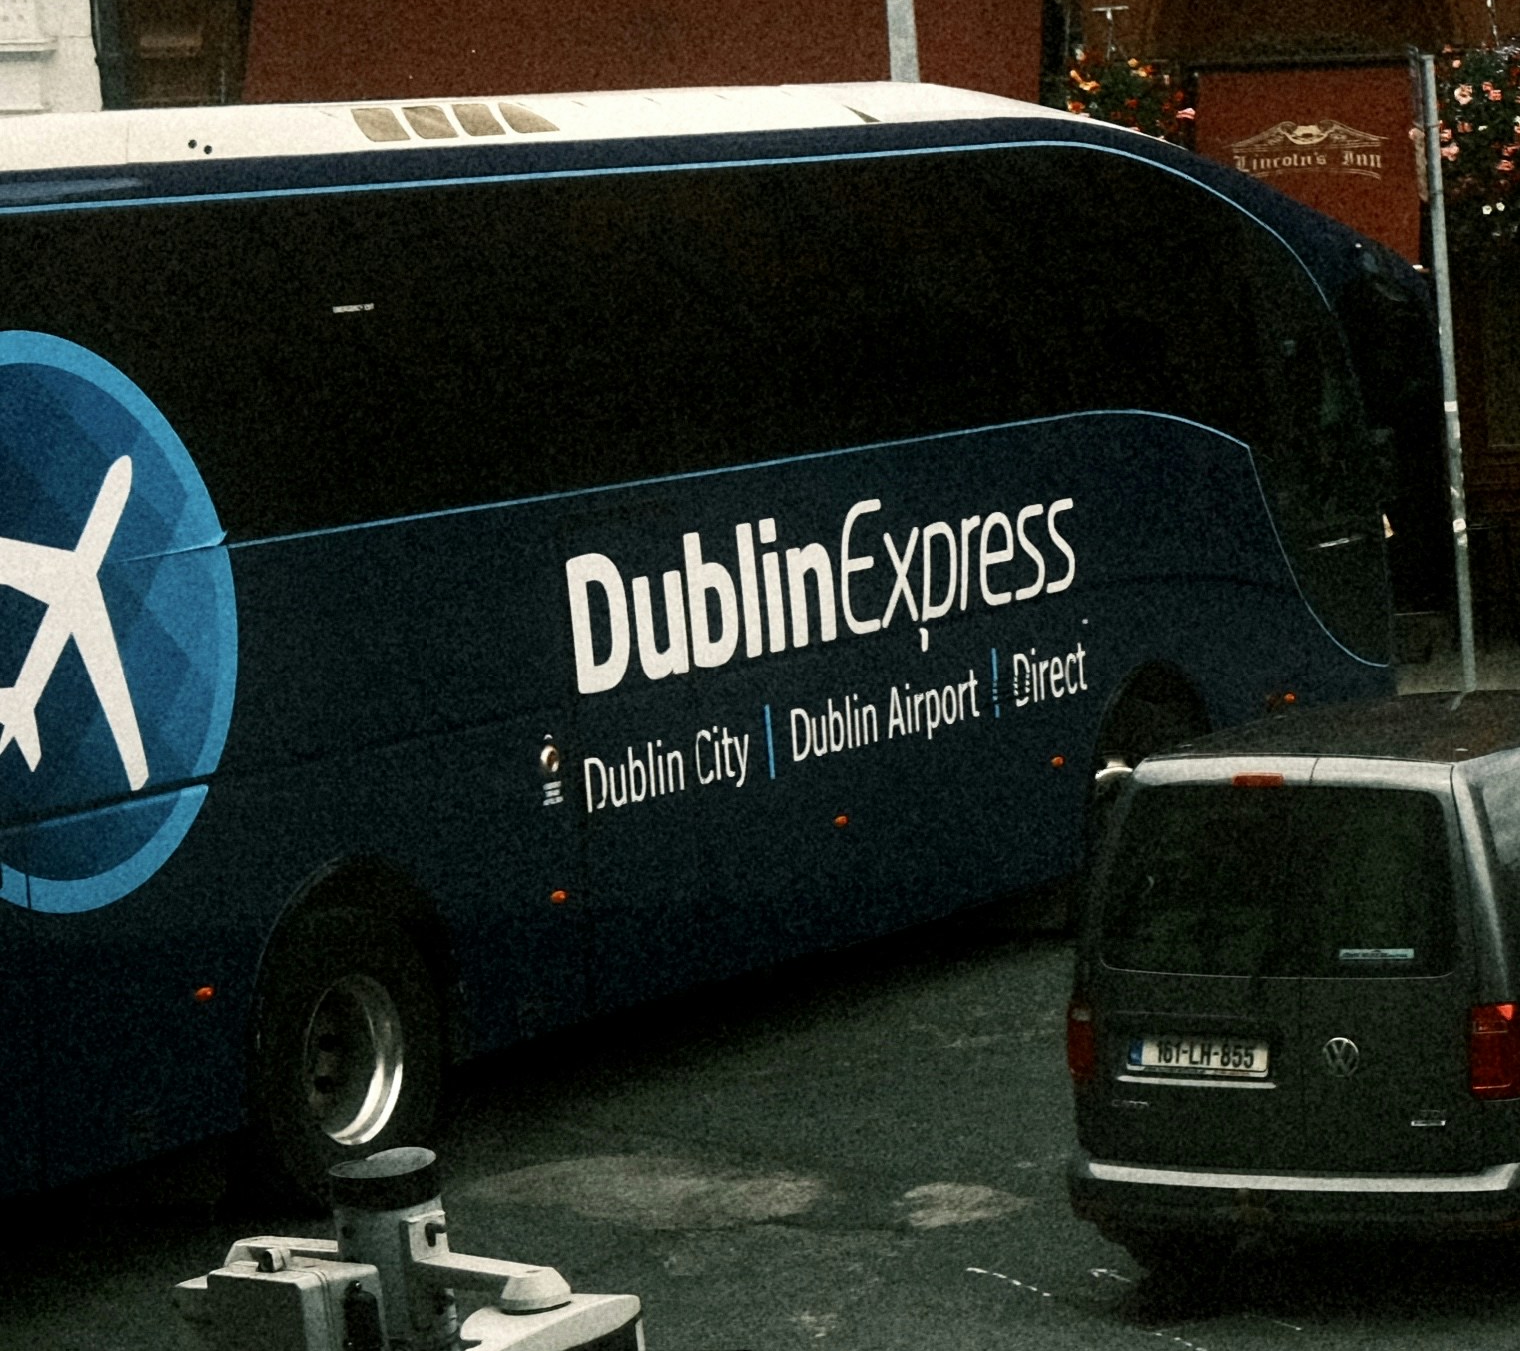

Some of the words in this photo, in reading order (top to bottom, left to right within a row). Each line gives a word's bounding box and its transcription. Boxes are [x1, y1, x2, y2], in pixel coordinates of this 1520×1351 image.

[1233, 151, 1328, 173] Lincoln's
[1341, 150, 1383, 169] Inn
[565, 498, 1075, 696] DublinExpress
[583, 739, 686, 813] Dublin
[695, 725, 750, 788] City
[790, 692, 878, 763] Dublin
[887, 669, 981, 740] Airport
[1012, 642, 1089, 708] Direct
[1154, 1039, 1255, 1070] 161-LH-855
